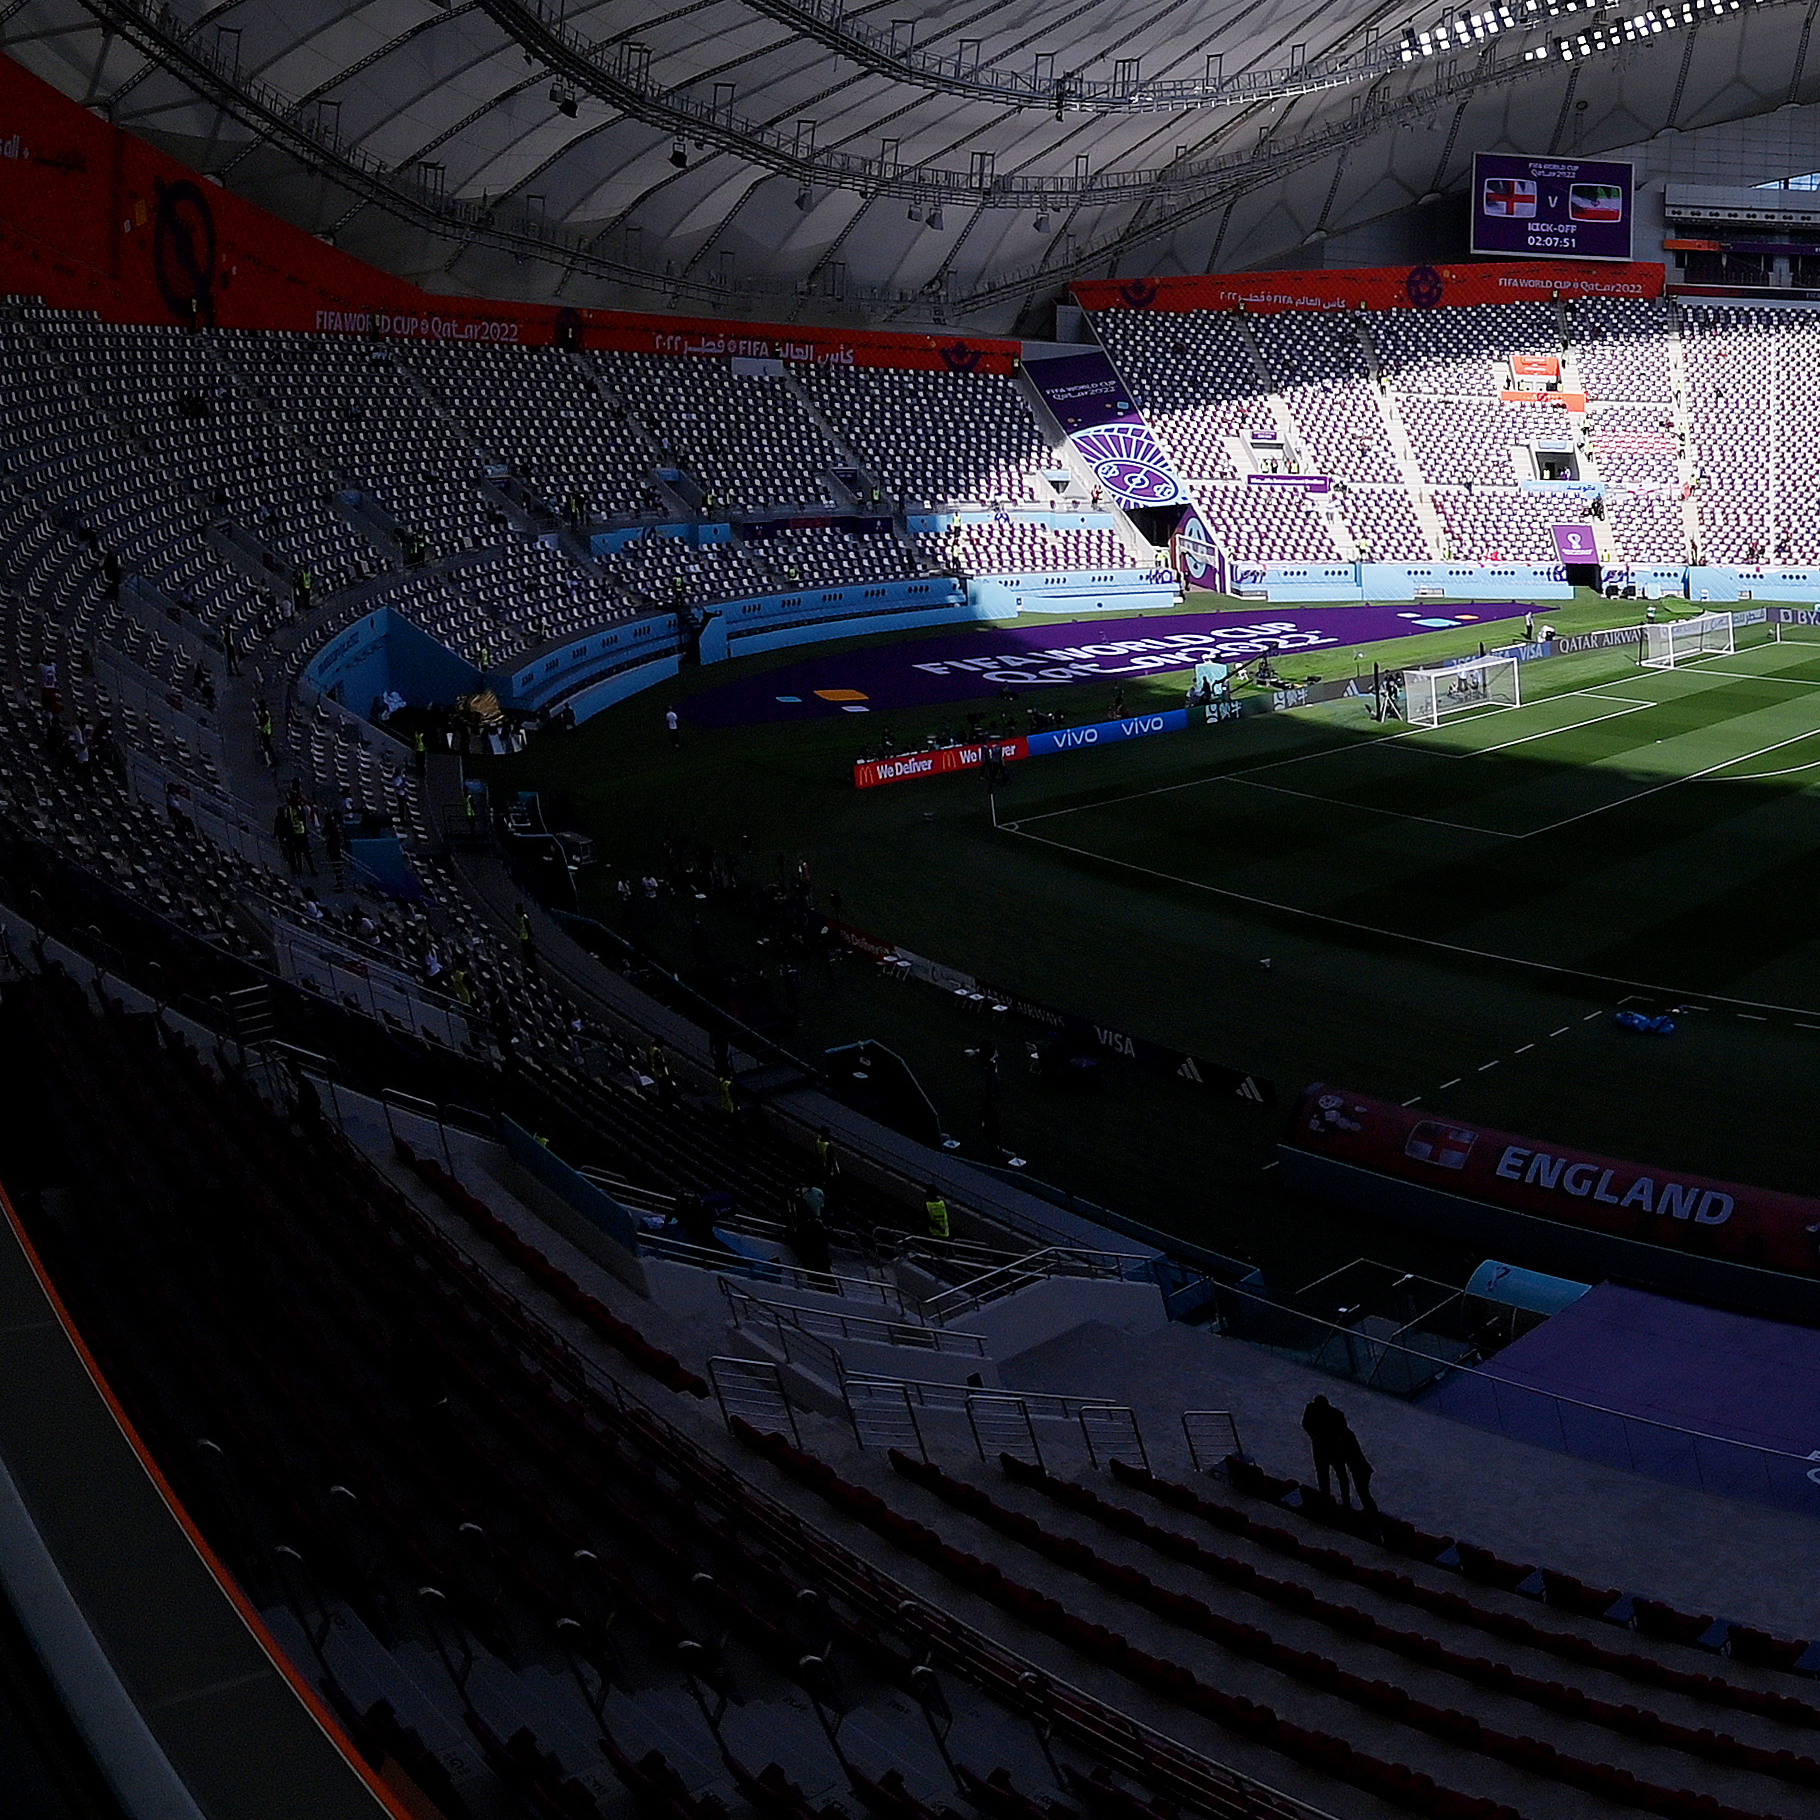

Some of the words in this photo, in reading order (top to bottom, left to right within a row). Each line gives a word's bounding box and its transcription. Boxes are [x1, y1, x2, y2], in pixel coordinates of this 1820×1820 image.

[1548, 196, 1558, 208] V
[1527, 222, 1577, 234] KICK-OFF
[1527, 236, 1577, 248] 02:07:51
[1498, 278, 1518, 287] FIFA
[1518, 279, 1551, 289] WORLD
[1553, 281, 1572, 289] CUP
[1580, 281, 1643, 293] Qatar2022
[1273, 294, 1293, 304] FIFA
[315, 310, 341, 331] FIFA
[393, 316, 419, 336] CUP
[431, 316, 519, 342] Qatar2022
[739, 340, 770, 357] FIFA
[912, 652, 1037, 675] FIFA
[1037, 633, 1215, 663] WORLD
[1212, 620, 1299, 639] CUP
[1519, 646, 1543, 661] VISA
[1559, 634, 1599, 654] QATAR
[982, 630, 1339, 684] Qatar2022
[1120, 715, 1164, 738] vivo
[1053, 727, 1098, 749] vivo
[959, 749, 977, 764] We
[877, 764, 894, 780] We
[895, 757, 933, 777] Deliver
[1093, 1024, 1137, 1059] VISA
[1495, 1145, 1735, 1226] ENGLAND
